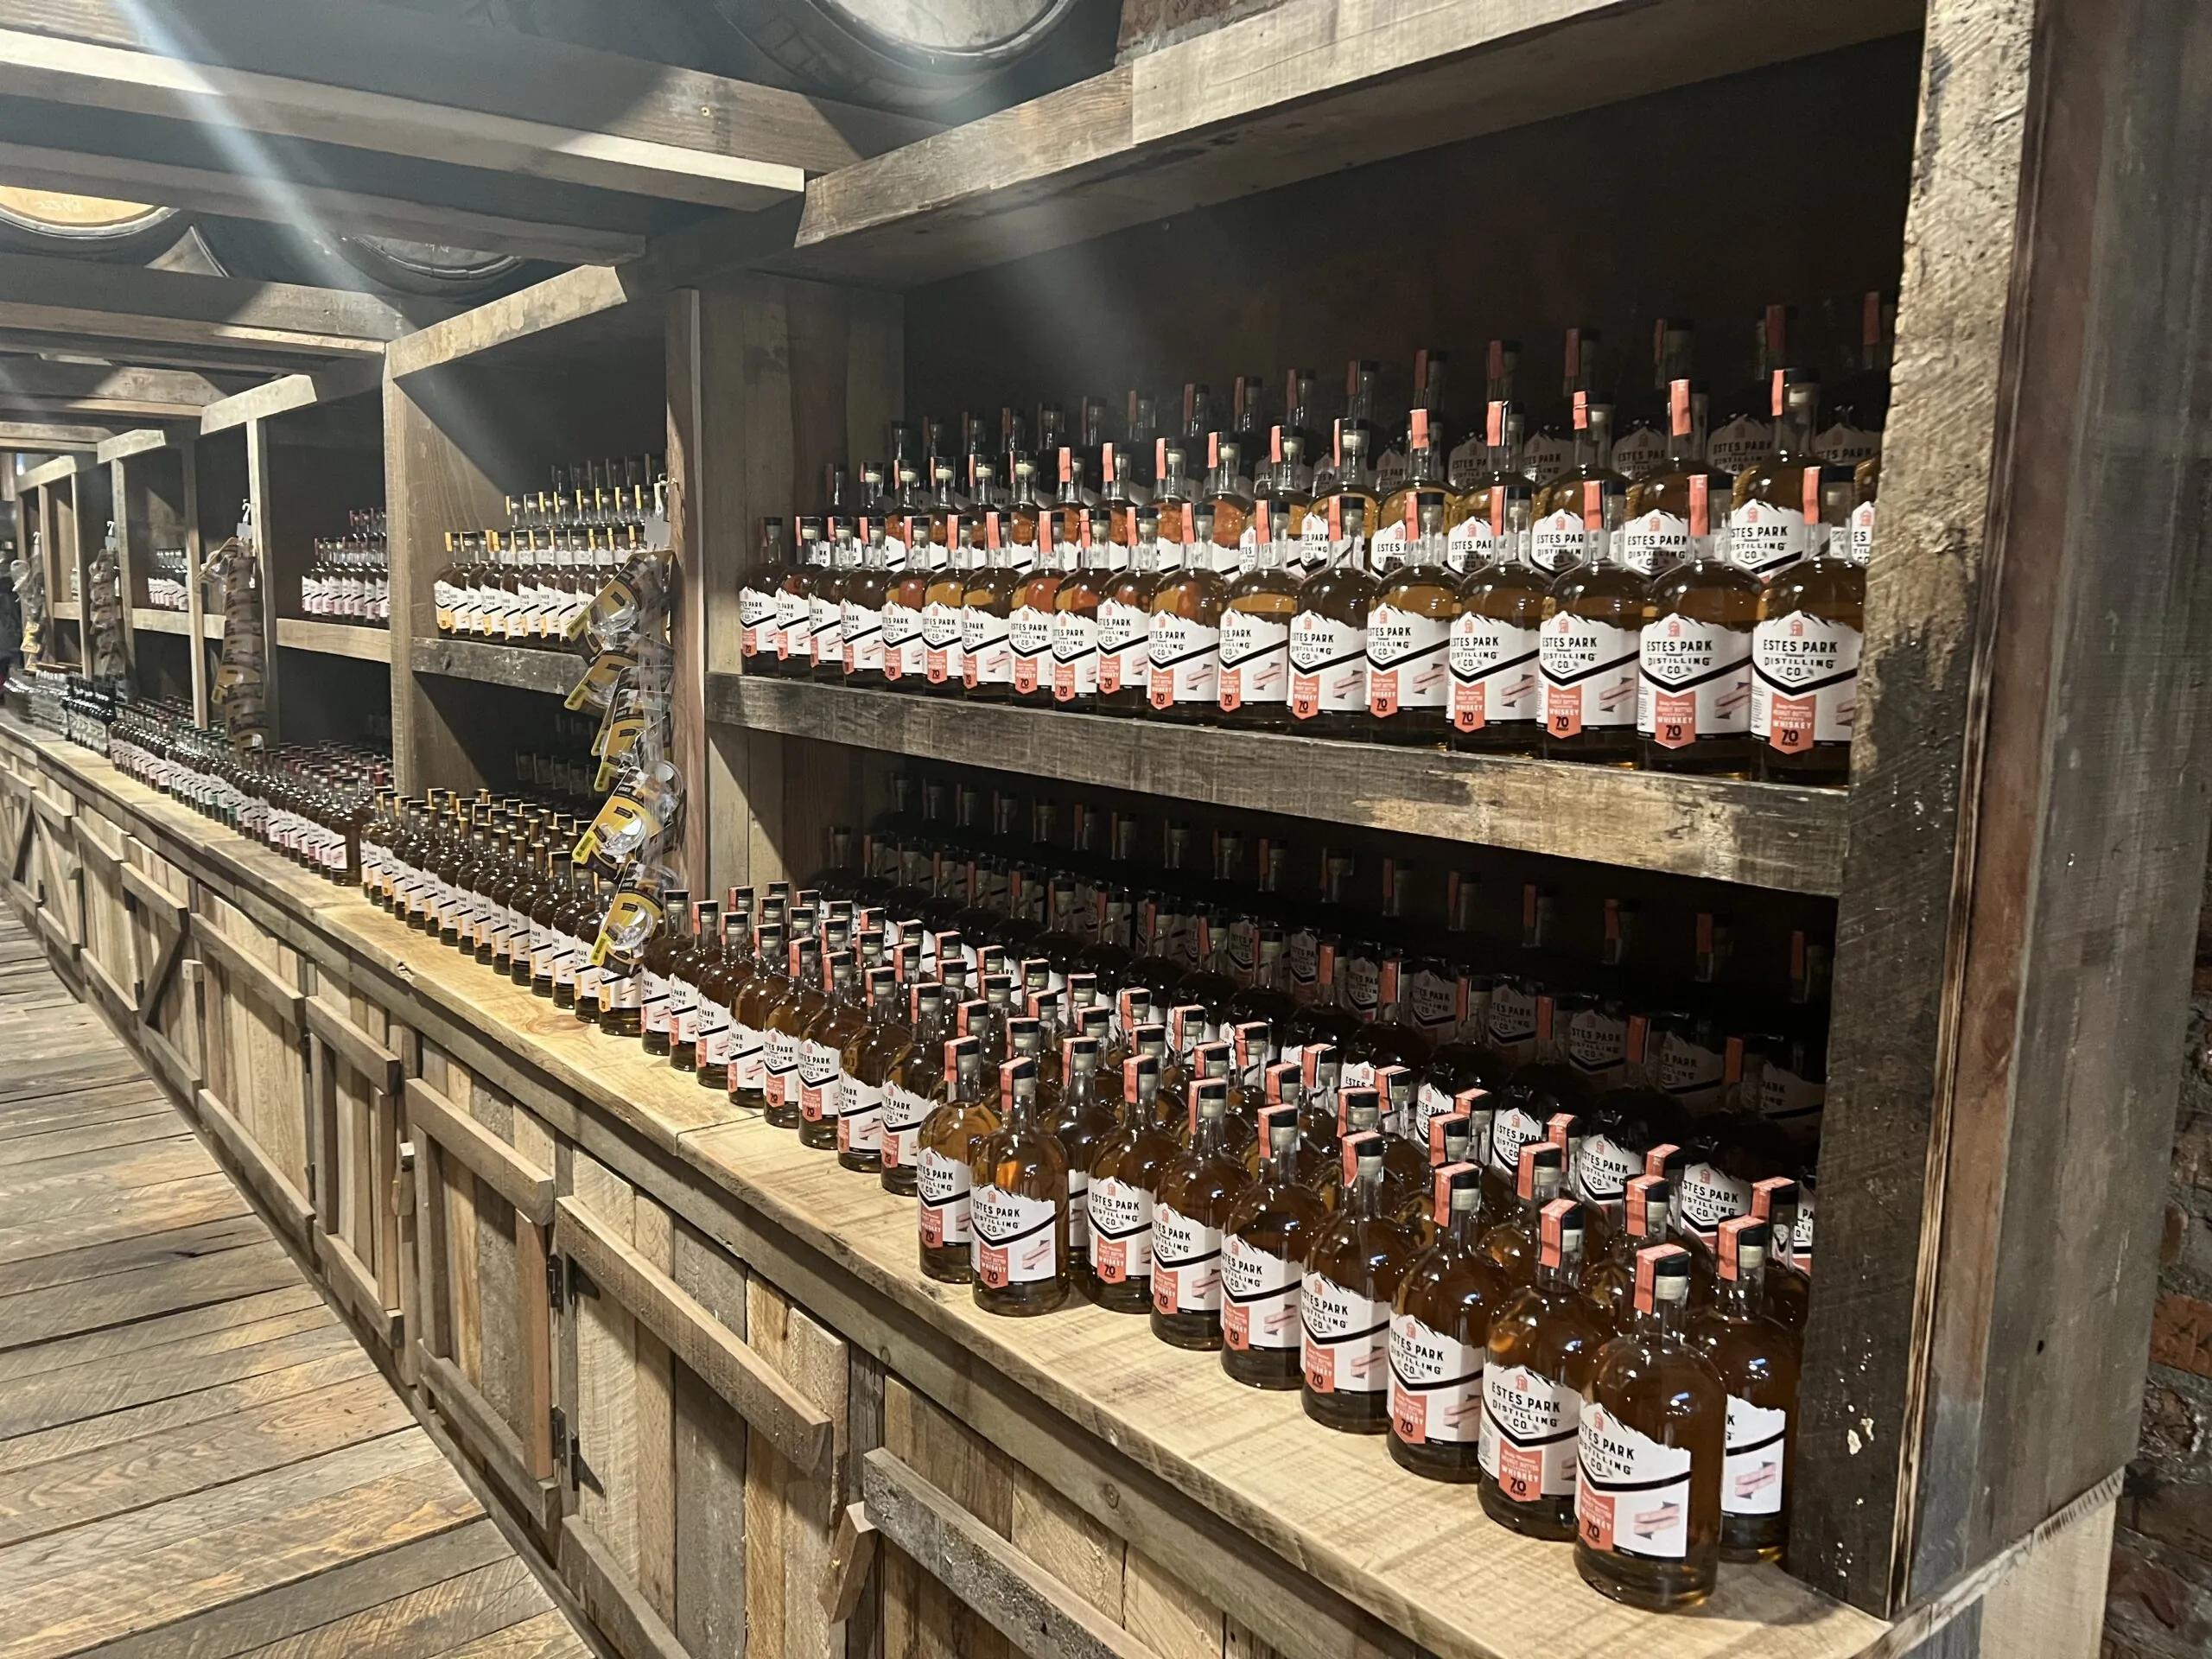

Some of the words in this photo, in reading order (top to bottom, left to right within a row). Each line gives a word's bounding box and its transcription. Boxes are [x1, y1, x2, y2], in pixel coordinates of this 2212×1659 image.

[1758, 525, 1788, 537] PARK
[1628, 536, 1656, 545] ESTES
[1165, 631, 1185, 639] PARK
[1232, 629, 1252, 638] PARK
[1311, 633, 1334, 643] PARK
[1387, 626, 1411, 637] PARK
[1472, 636, 1499, 646] PARK
[1542, 637, 1565, 647] ESTES
[1569, 637, 1598, 647] PARK
[1647, 641, 1675, 652] ESTES
[1681, 639, 1713, 652] PARK
[1764, 639, 1797, 652] ESTES
[1802, 640, 1838, 653] PARK
[1299, 701, 1309, 712] 70
[1376, 698, 1387, 709] 70
[1462, 711, 1473, 722] 70
[1555, 716, 1569, 728] 70
[1666, 725, 1681, 736] 70
[1772, 720, 1812, 729] WHISKEY
[1782, 729, 1799, 742] 70
[893, 1100, 911, 1111] PARK
[1603, 1159, 1629, 1174] PARK
[933, 1169, 953, 1180] PARK
[1091, 1192, 1113, 1207] ESTES
[1116, 1200, 1140, 1211] PARK
[1710, 1187, 1738, 1204] PARK
[996, 1207, 1020, 1217] PARK
[925, 1229, 935, 1243] 70
[1168, 1227, 1191, 1242] PARK
[1104, 1264, 1116, 1277] 70
[1238, 1260, 1262, 1275] PARK
[988, 1269, 999, 1283] 70
[1158, 1294, 1169, 1307] 70
[1322, 1300, 1348, 1316] PARK
[1229, 1328, 1239, 1342] 70
[1415, 1344, 1444, 1362] PARK
[1312, 1370, 1324, 1385] 70
[1491, 1380, 1522, 1405] ESTES
[1528, 1397, 1560, 1414] PARK
[1401, 1418, 1414, 1433] 70
[1603, 1437, 1635, 1461] PARK
[1510, 1477, 1527, 1492] 70
[1586, 1520, 1600, 1538] 70
